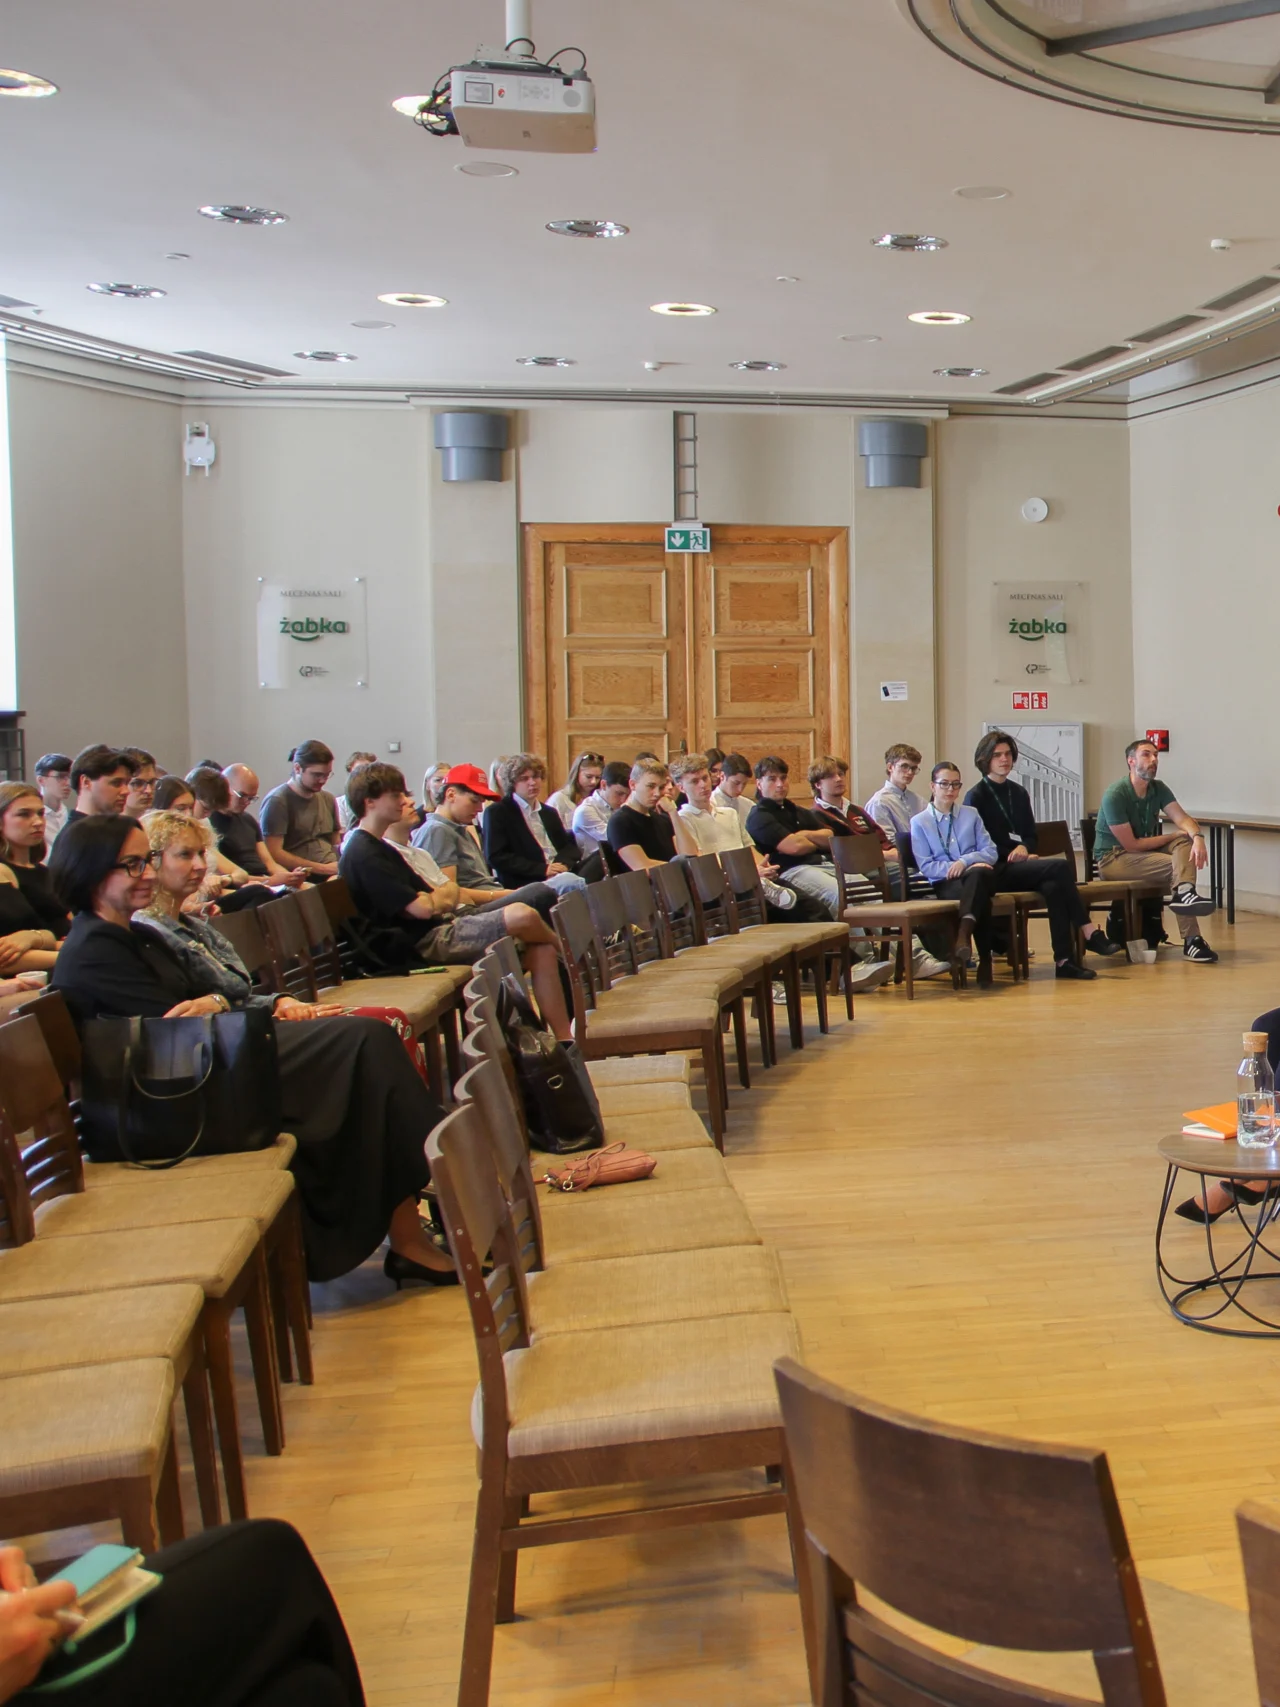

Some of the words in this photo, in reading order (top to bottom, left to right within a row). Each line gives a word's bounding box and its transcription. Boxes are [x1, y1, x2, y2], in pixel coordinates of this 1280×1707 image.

[1048, 593, 1064, 601] SALI
[280, 616, 347, 635] żabka
[1008, 618, 1067, 635] żabka
